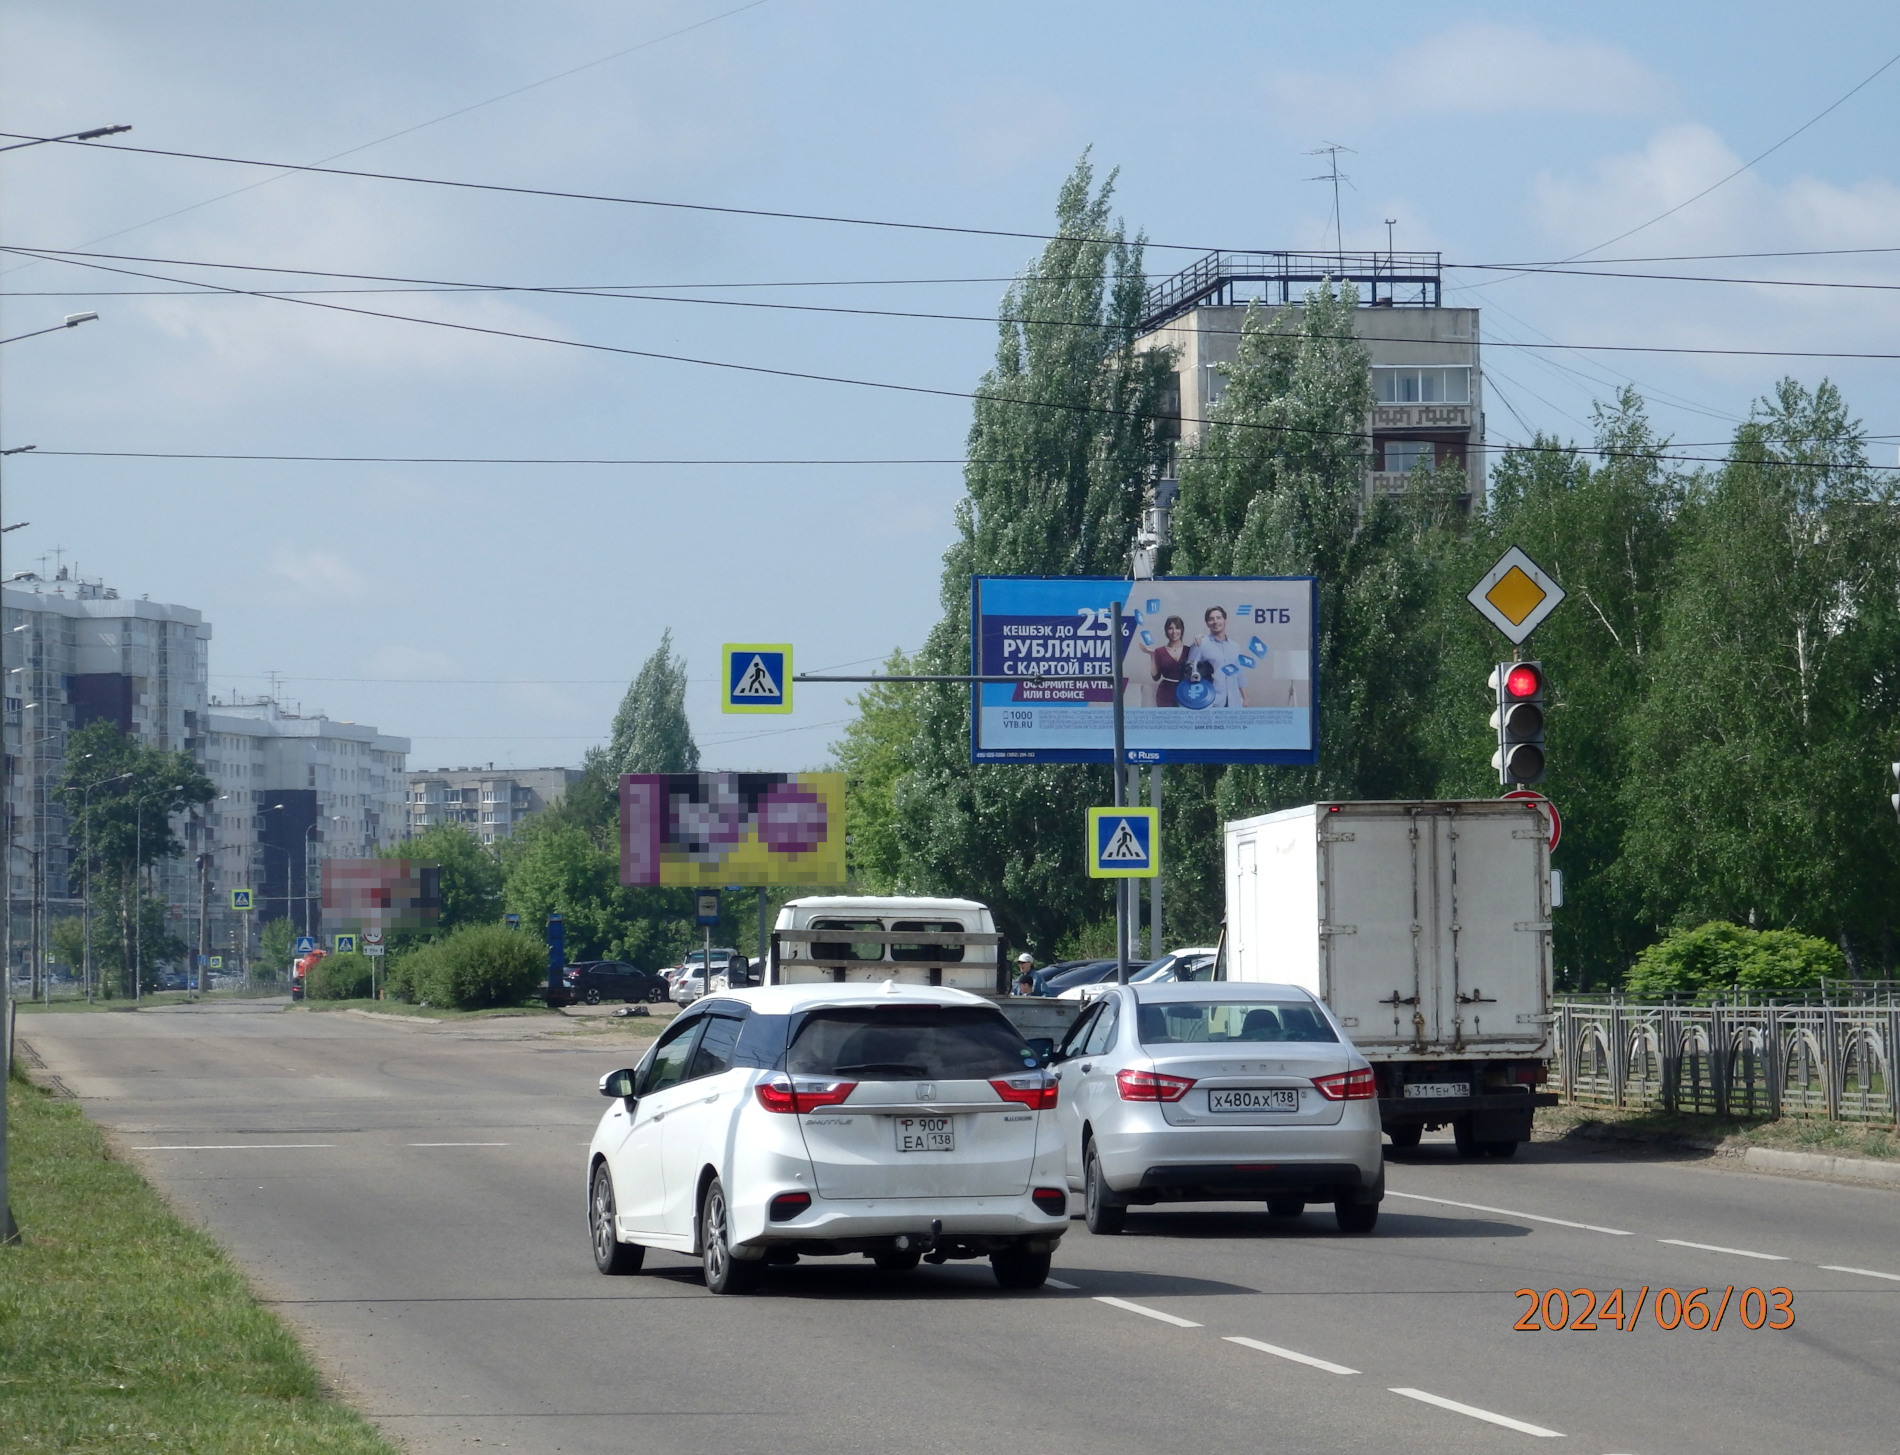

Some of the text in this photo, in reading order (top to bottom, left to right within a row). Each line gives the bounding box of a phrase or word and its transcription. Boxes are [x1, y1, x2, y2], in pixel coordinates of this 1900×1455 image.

[1254, 608, 1291, 624] ВТБ
[1003, 625, 1053, 636] КЕШБЭК
[1055, 625, 1074, 638] ДО
[1003, 639, 1111, 658] РУБЛЯМИ
[1003, 659, 1112, 675] С КАРТОЙ ВТБ
[1076, 680, 1089, 689] НА
[1023, 690, 1085, 699] ИЛИ В ОФИСЕ
[1010, 711, 1033, 720] 1000
[1003, 720, 1033, 729] VTB.RU
[1138, 751, 1160, 760] Russ
[1272, 1091, 1294, 1103] 138
[919, 1118, 944, 1132] 900
[903, 1134, 951, 1149] ЕА 138
